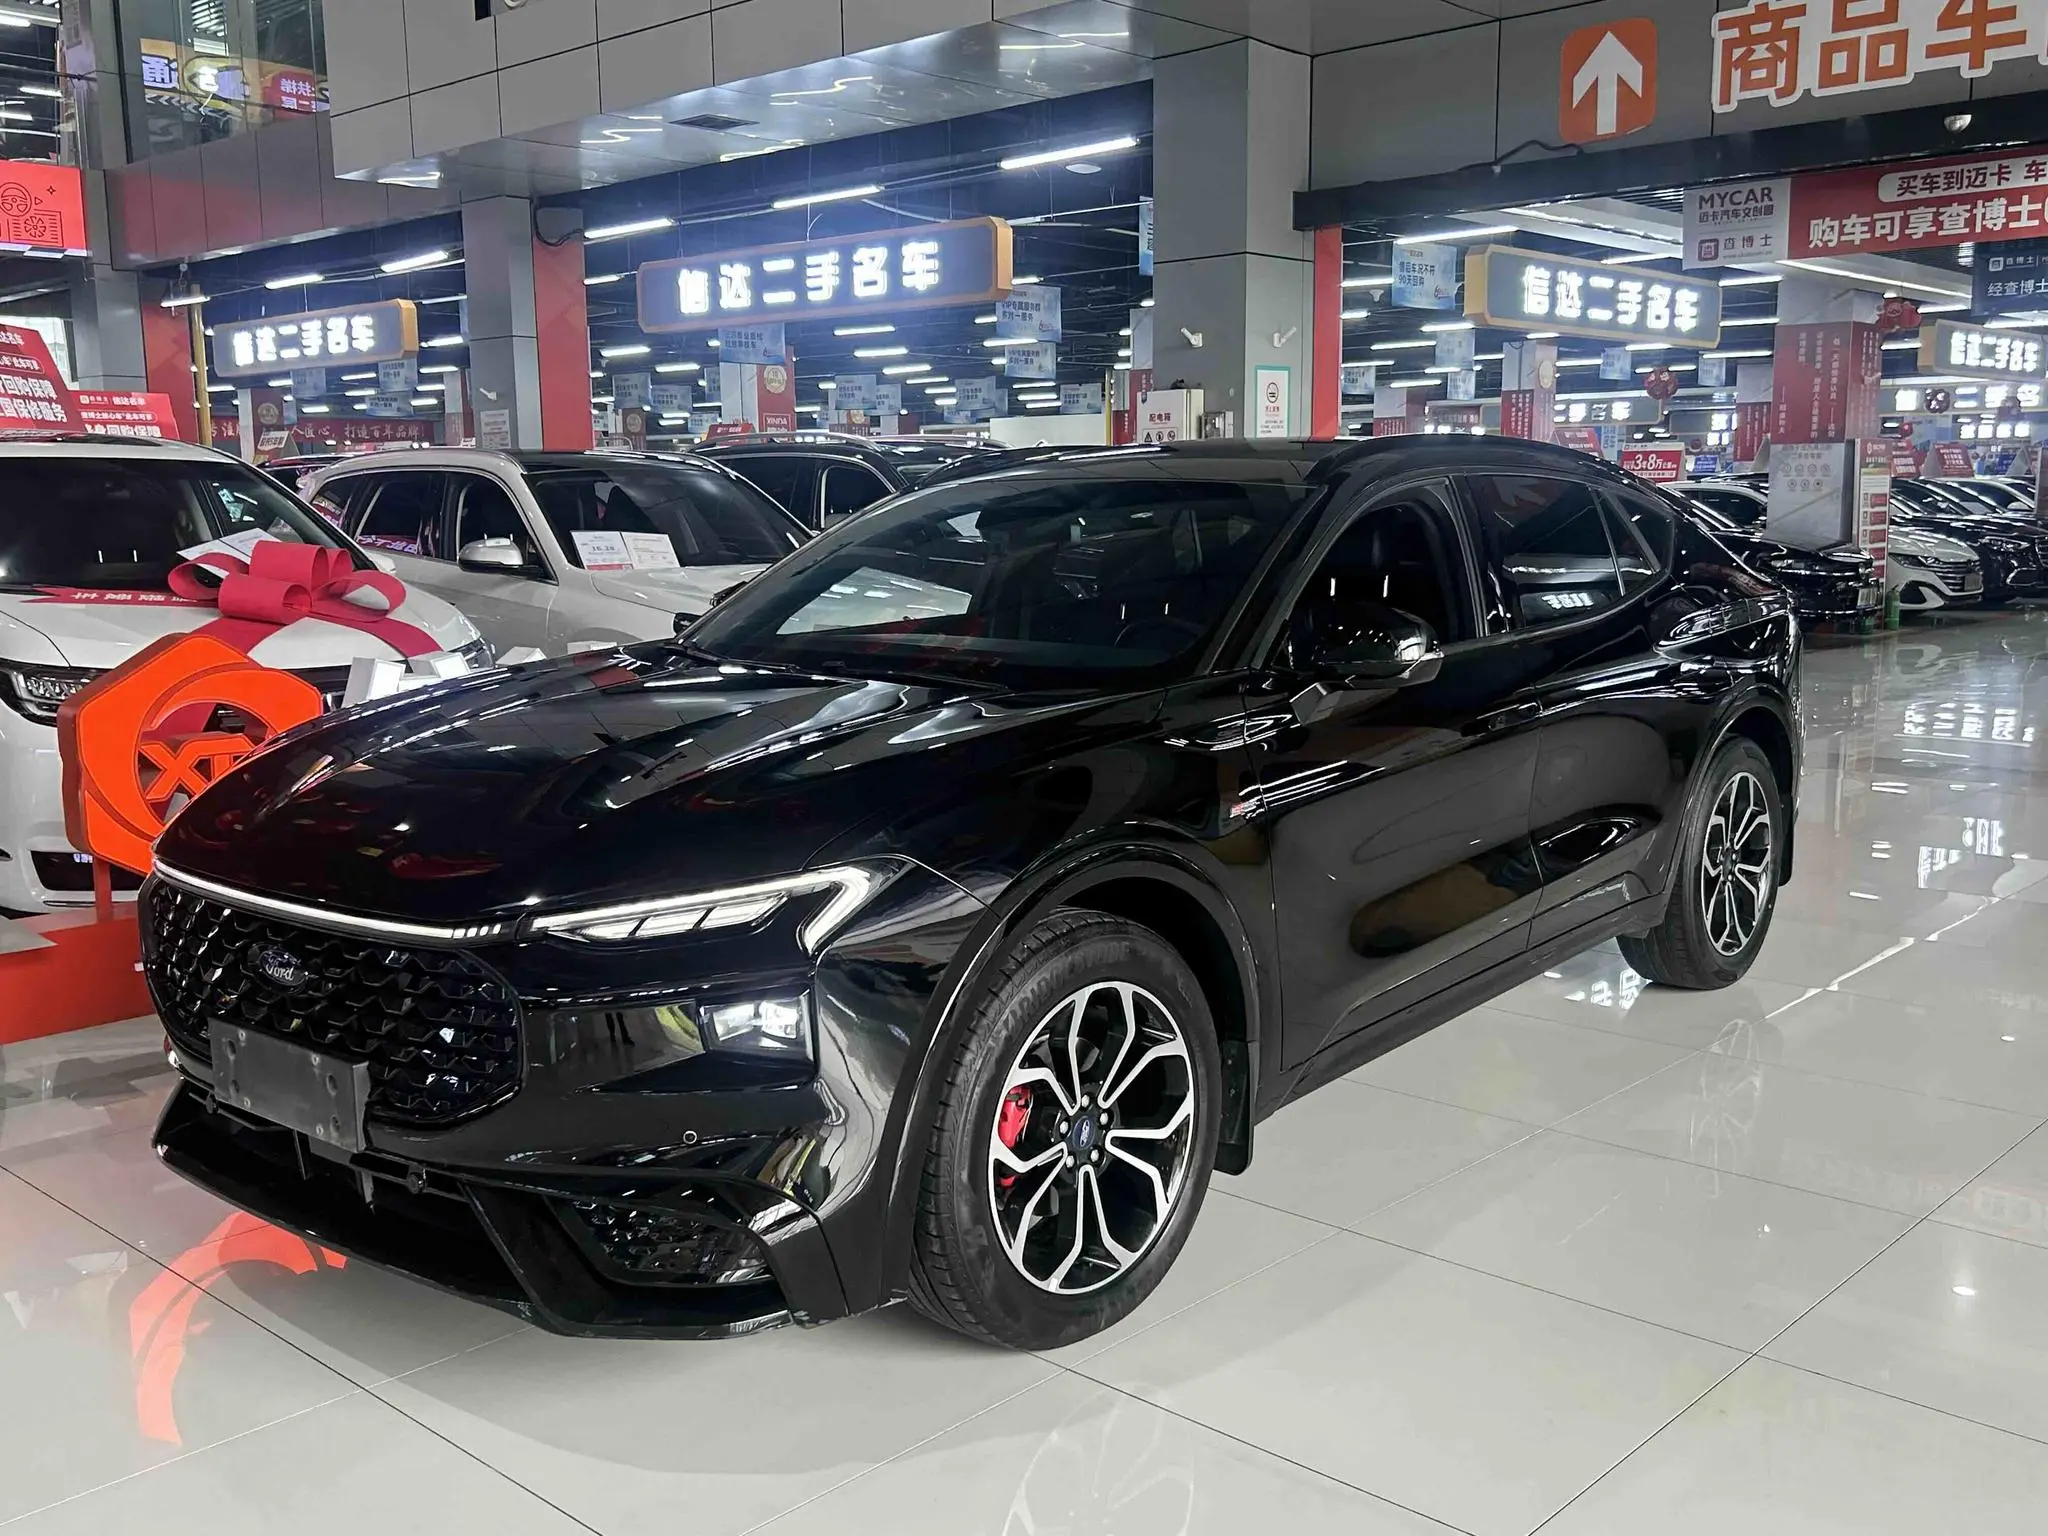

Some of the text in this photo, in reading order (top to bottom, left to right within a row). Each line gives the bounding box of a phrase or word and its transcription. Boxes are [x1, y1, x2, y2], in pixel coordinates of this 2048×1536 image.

[1698, 186, 1774, 211] MYCAR
[1896, 163, 2012, 198] 买车到迈卡
[1808, 194, 2048, 250] 购车可享查博士
[678, 241, 941, 316] 信达二手名车
[1522, 264, 1699, 333] 信达二手名车
[1149, 412, 1171, 423] 配电箱
